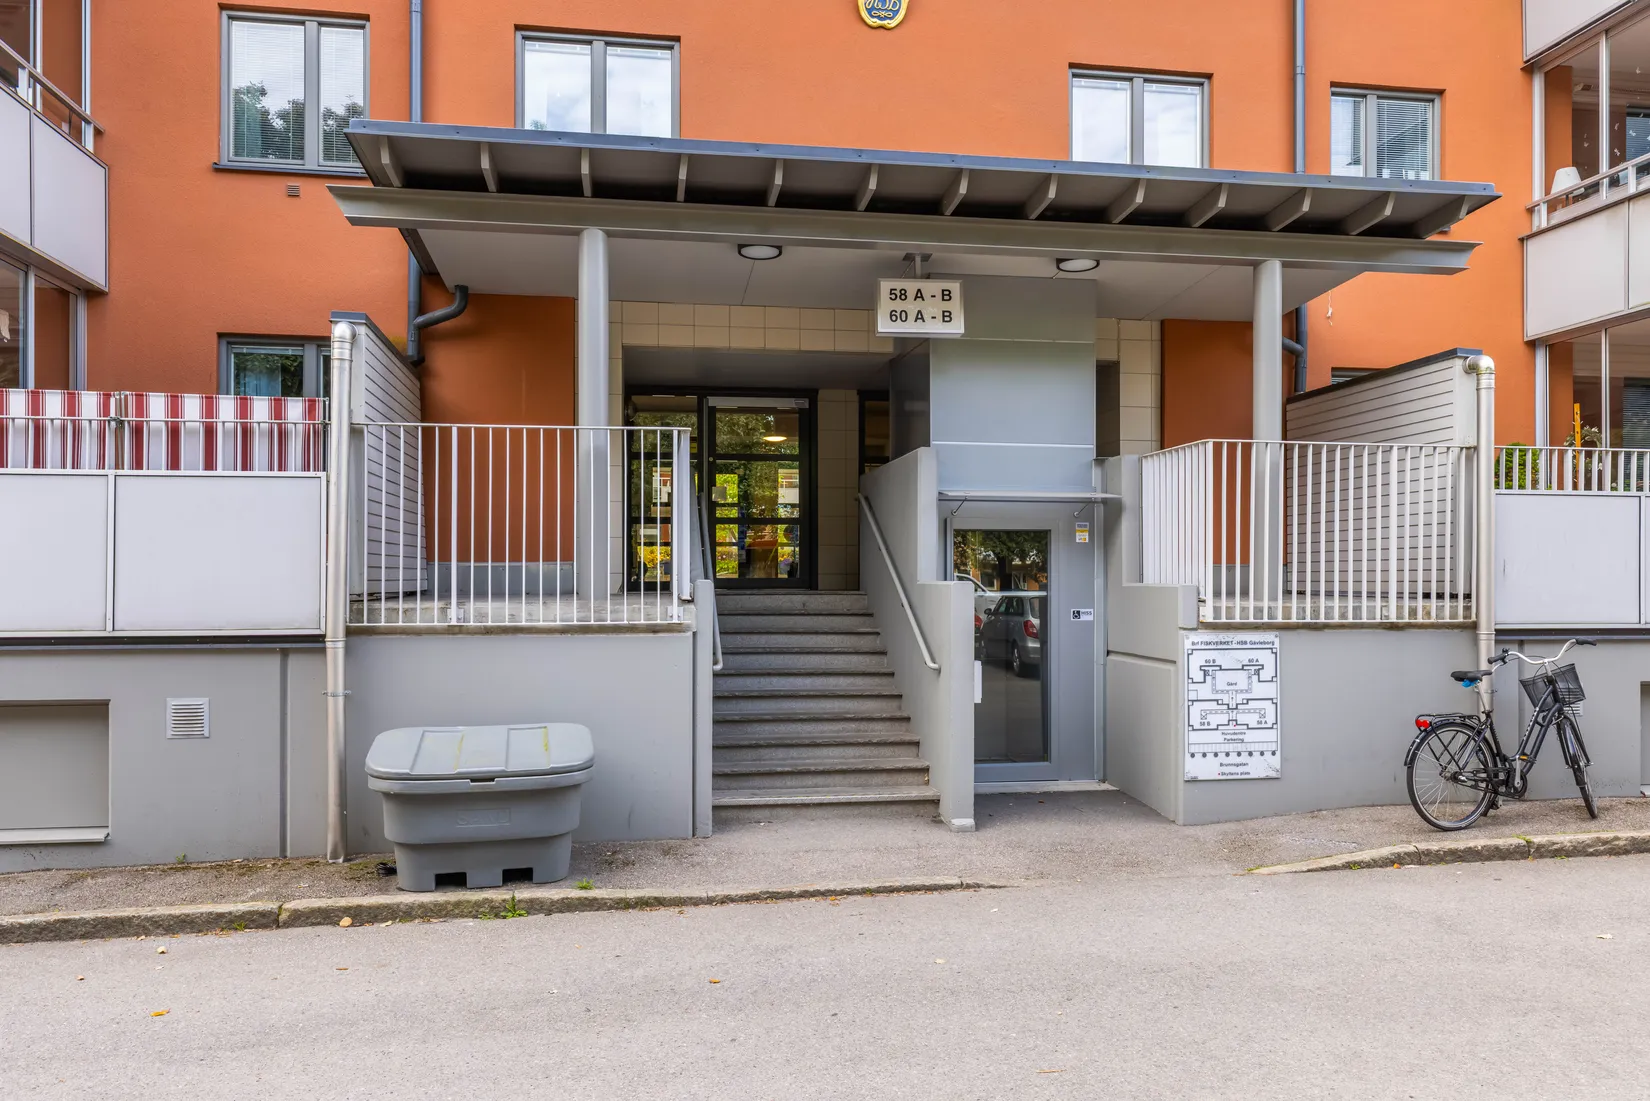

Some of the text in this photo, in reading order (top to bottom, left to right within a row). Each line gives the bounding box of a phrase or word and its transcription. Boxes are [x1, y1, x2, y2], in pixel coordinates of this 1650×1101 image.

[889, 288, 908, 301] 58
[913, 288, 925, 301] A
[941, 289, 952, 301] B
[889, 309, 908, 323] 60
[914, 309, 925, 323] A
[942, 310, 953, 323] B
